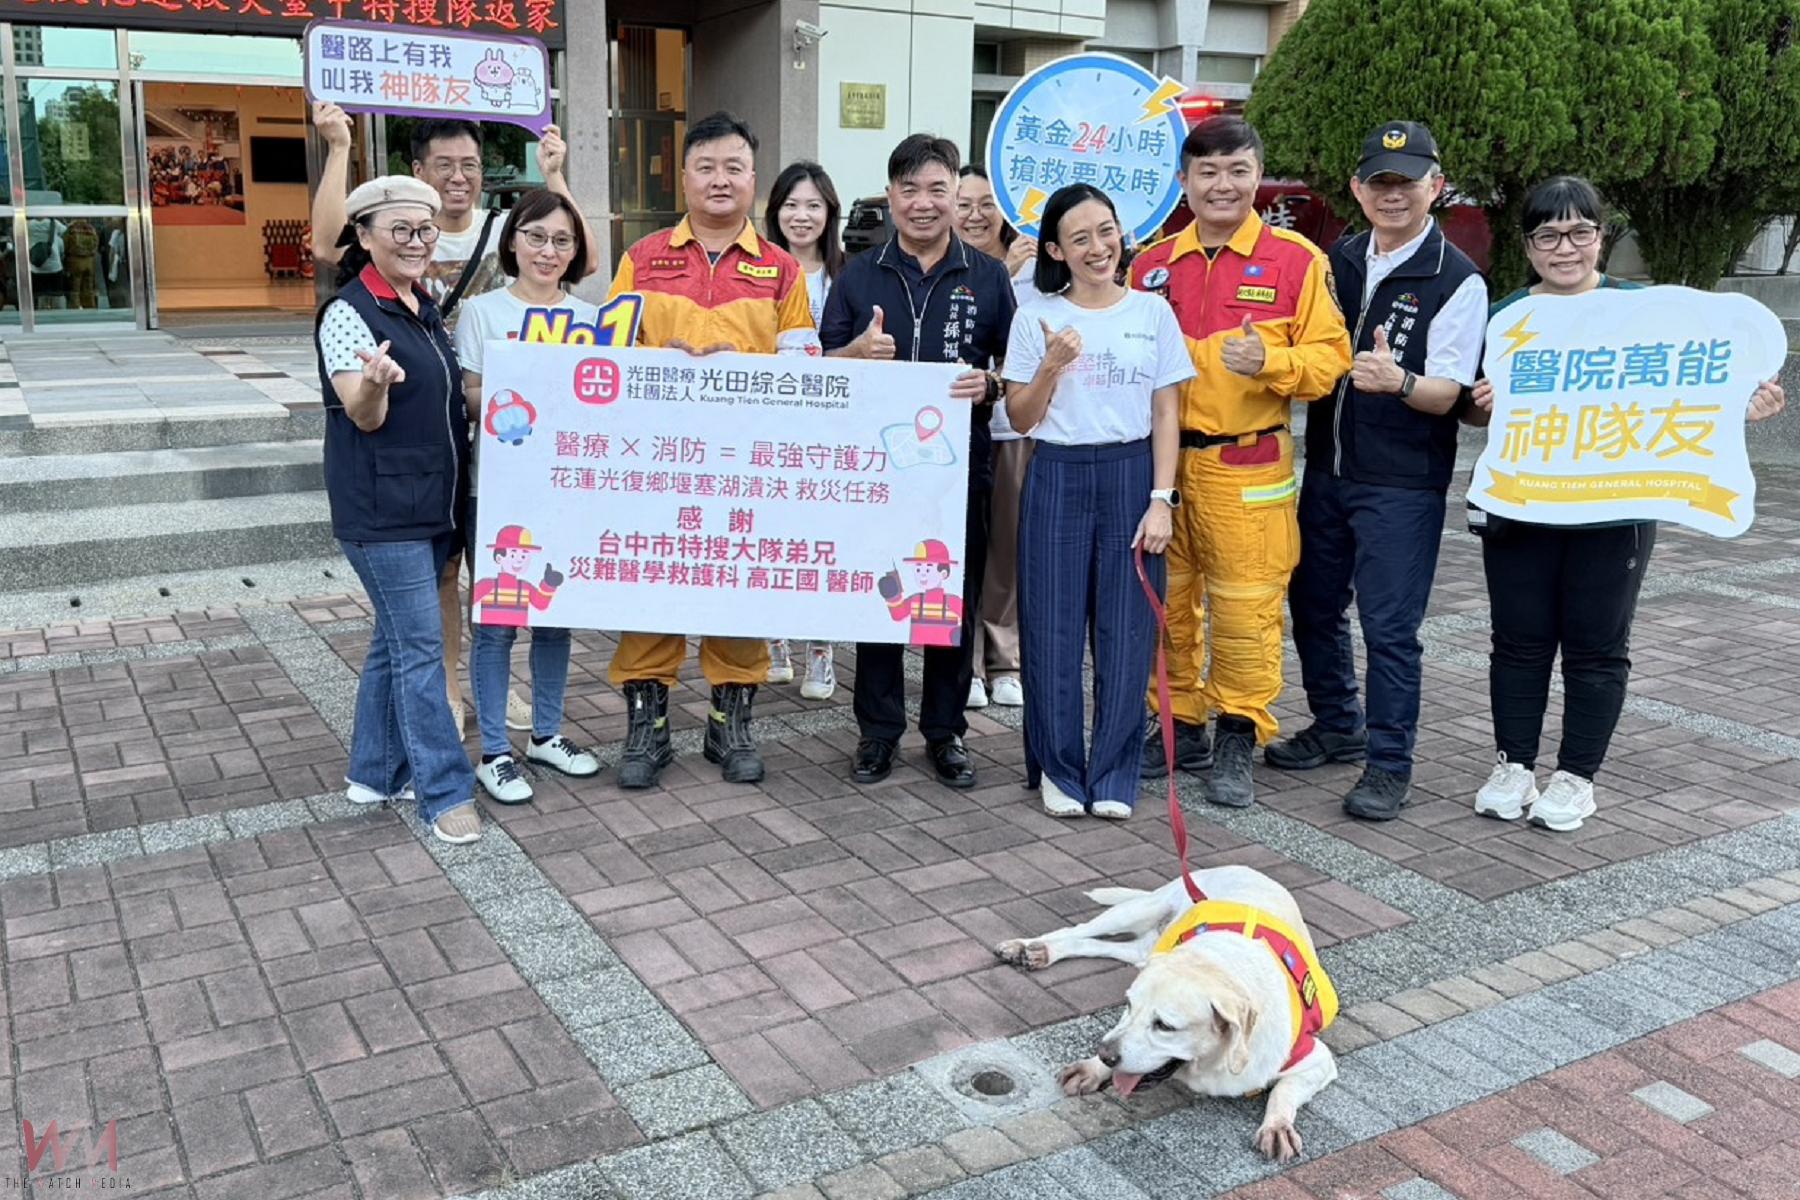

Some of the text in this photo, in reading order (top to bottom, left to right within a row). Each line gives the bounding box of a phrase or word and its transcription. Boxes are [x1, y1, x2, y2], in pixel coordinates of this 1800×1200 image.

[321, 34, 453, 69] 醫路上有我
[321, 68, 473, 106] 叫我神隊友
[1013, 114, 1166, 157] 黃金24小時
[1008, 154, 1160, 196] 搶救要及時
[627, 365, 696, 383] 光田醫療
[700, 368, 850, 399] 光田綜合醫院
[1508, 338, 1732, 395] 醫院萬能
[627, 383, 696, 402] 社團法人
[700, 395, 849, 411] Kuang Tien General Hospital
[1500, 398, 1723, 463] 神隊友
[555, 430, 609, 459] 醫療
[652, 435, 707, 465] 消防
[749, 440, 887, 473] 最強守護力
[550, 465, 890, 505] 花蓮光復鄉堰塞湖潰決 救災任務
[1519, 478, 1558, 490] KUANG
[1590, 478, 1642, 489] GENERAL
[1645, 478, 1703, 491] HOSPITAL
[598, 529, 837, 566] 台中市特搜大隊弟兄
[568, 555, 874, 594] 災難醫學救護科 高正國 醫師
